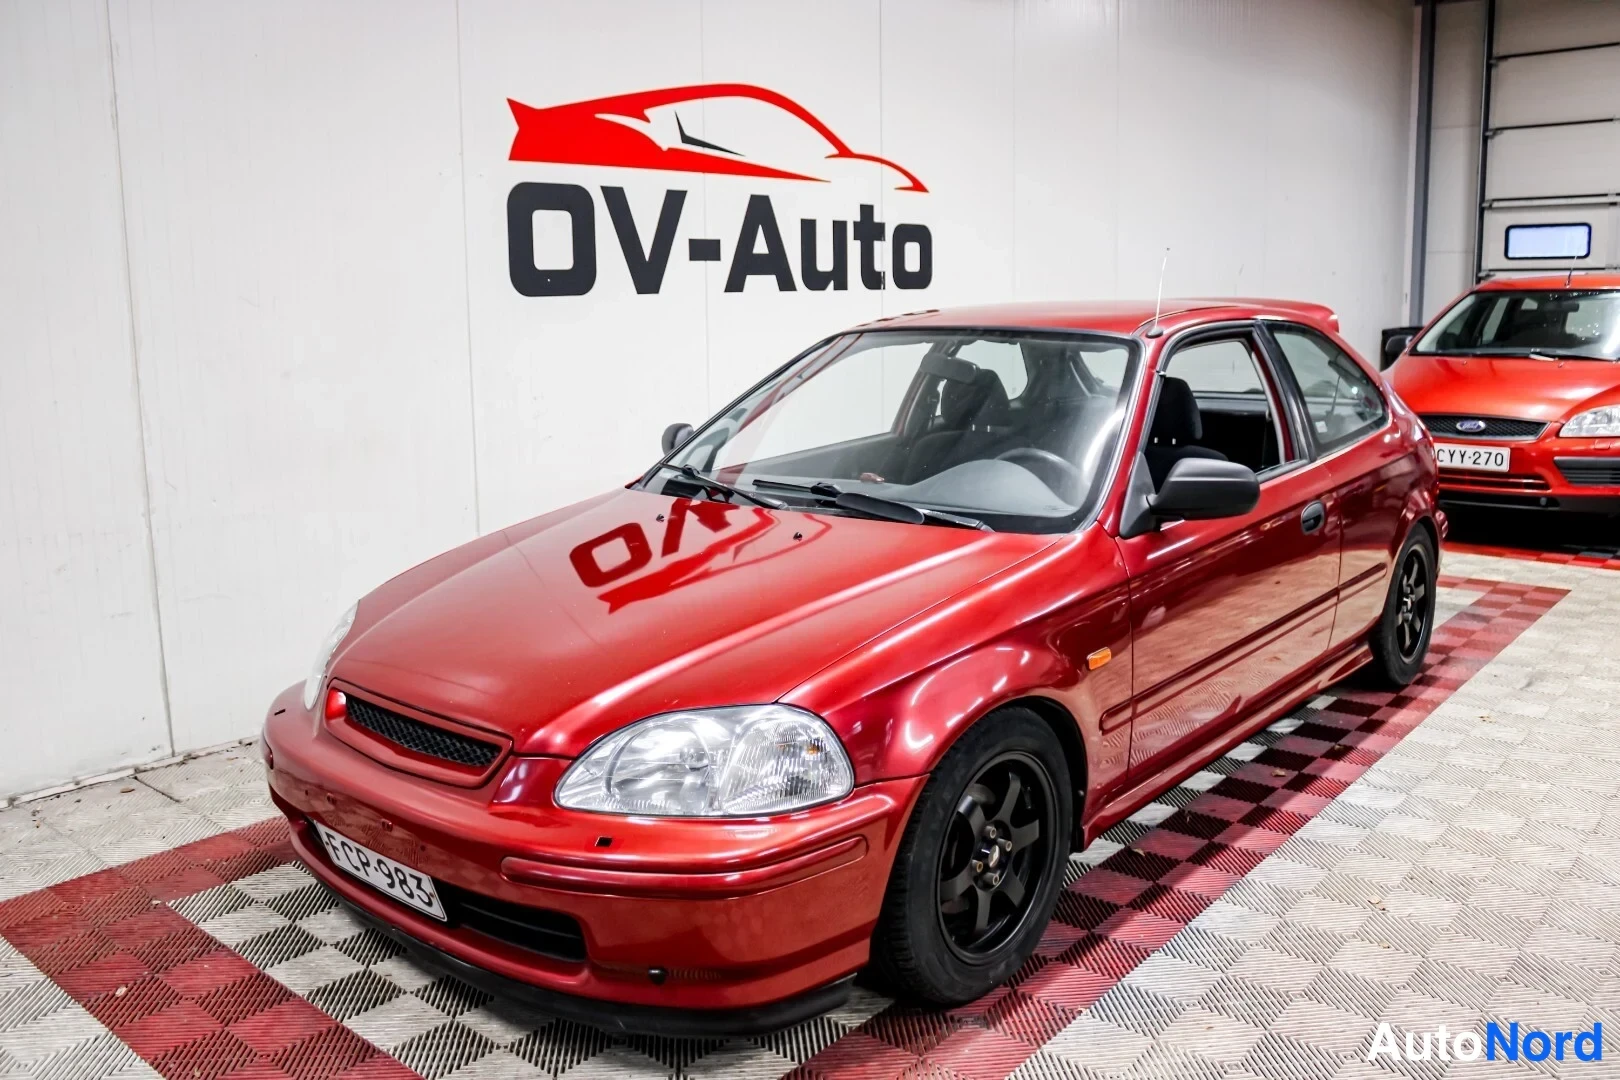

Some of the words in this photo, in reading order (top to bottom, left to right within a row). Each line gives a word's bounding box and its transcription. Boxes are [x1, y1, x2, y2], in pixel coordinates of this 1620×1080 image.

[507, 181, 933, 297] OV-Auto
[1436, 448, 1504, 467] CYY-270
[325, 831, 433, 908] FCP-983
